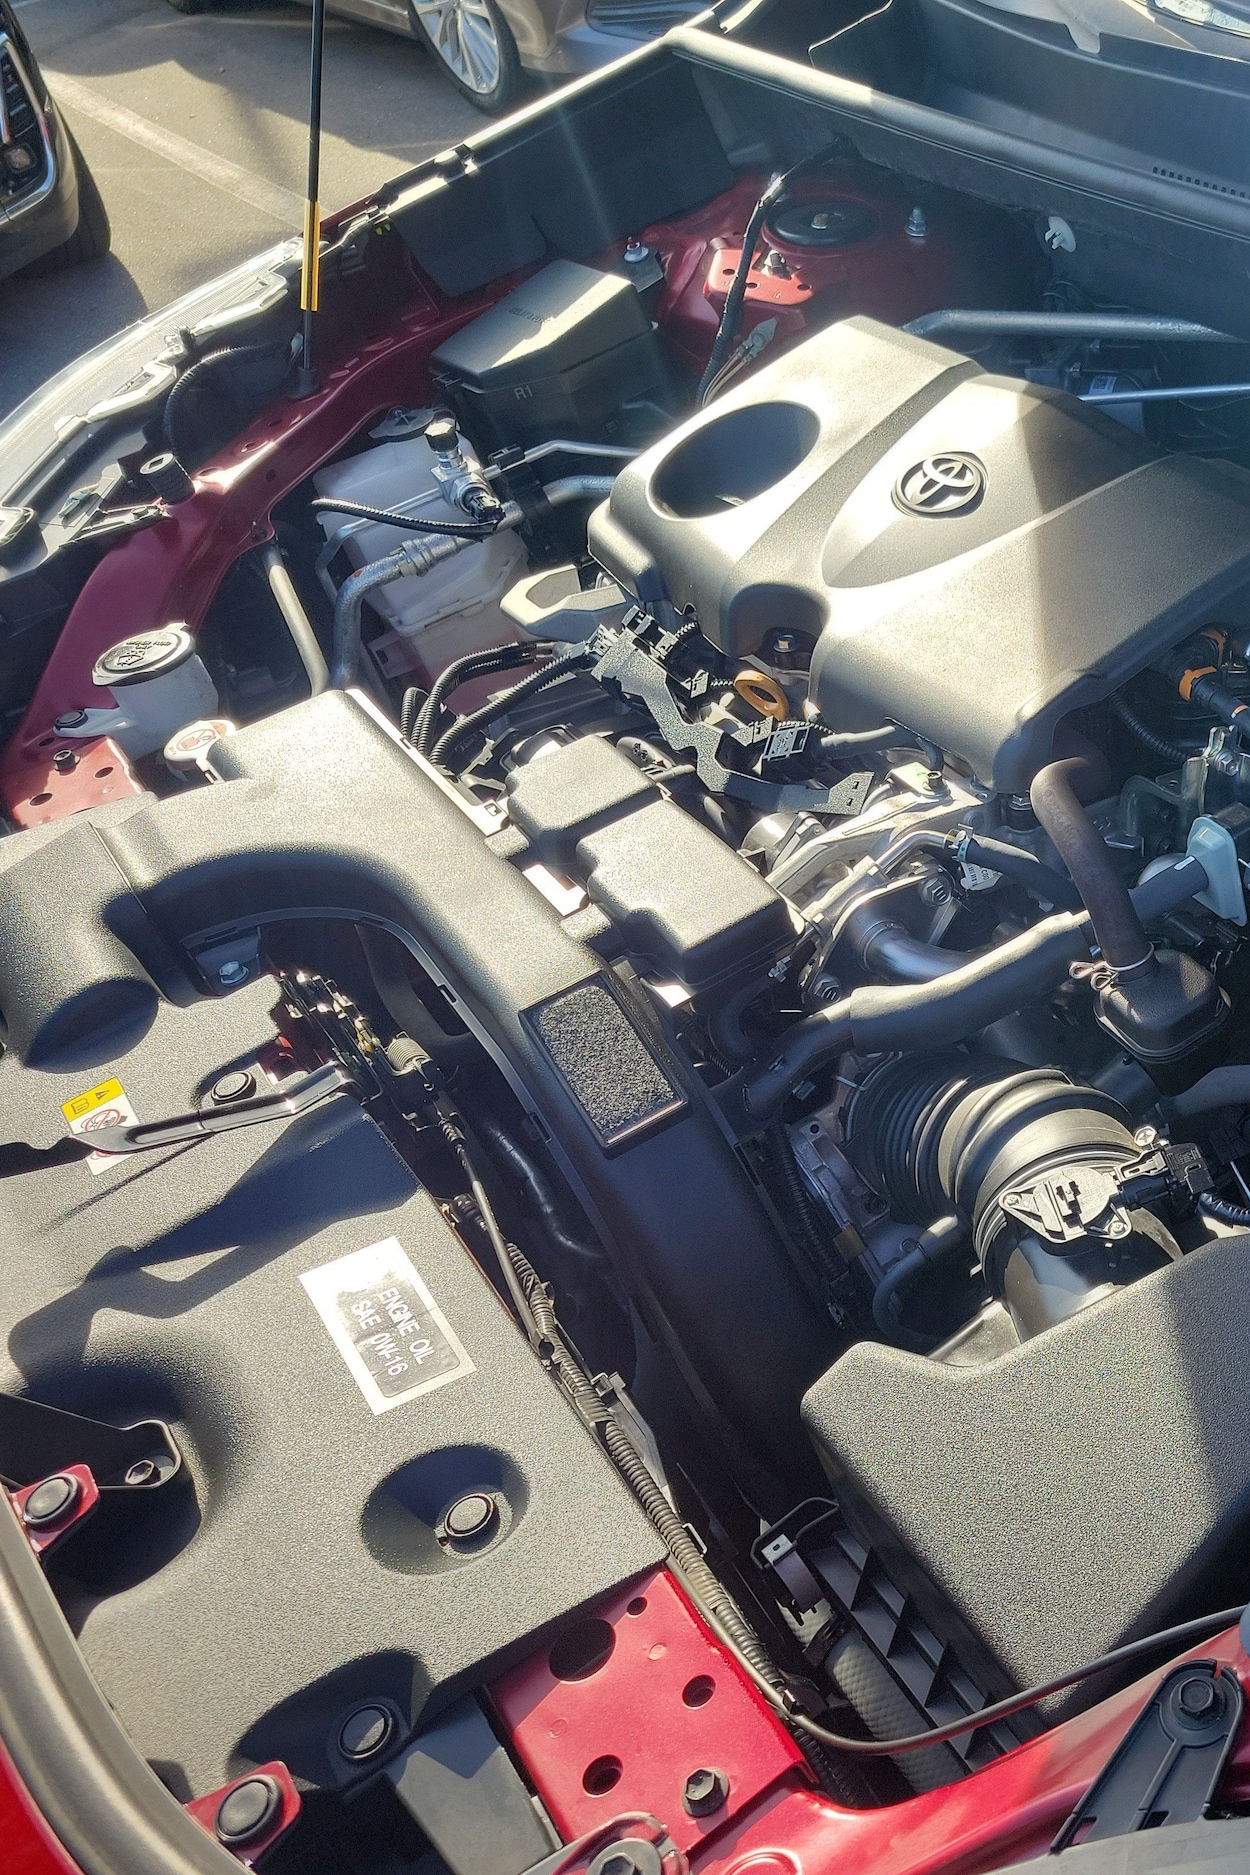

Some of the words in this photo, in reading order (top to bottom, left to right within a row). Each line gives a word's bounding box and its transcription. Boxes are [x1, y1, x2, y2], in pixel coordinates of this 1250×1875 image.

[514, 384, 533, 400] R1
[351, 1300, 381, 1329] SAE
[369, 1333, 409, 1376] 0W-16
[378, 1287, 420, 1337] ENGINE
[409, 1339, 436, 1365] OIL
